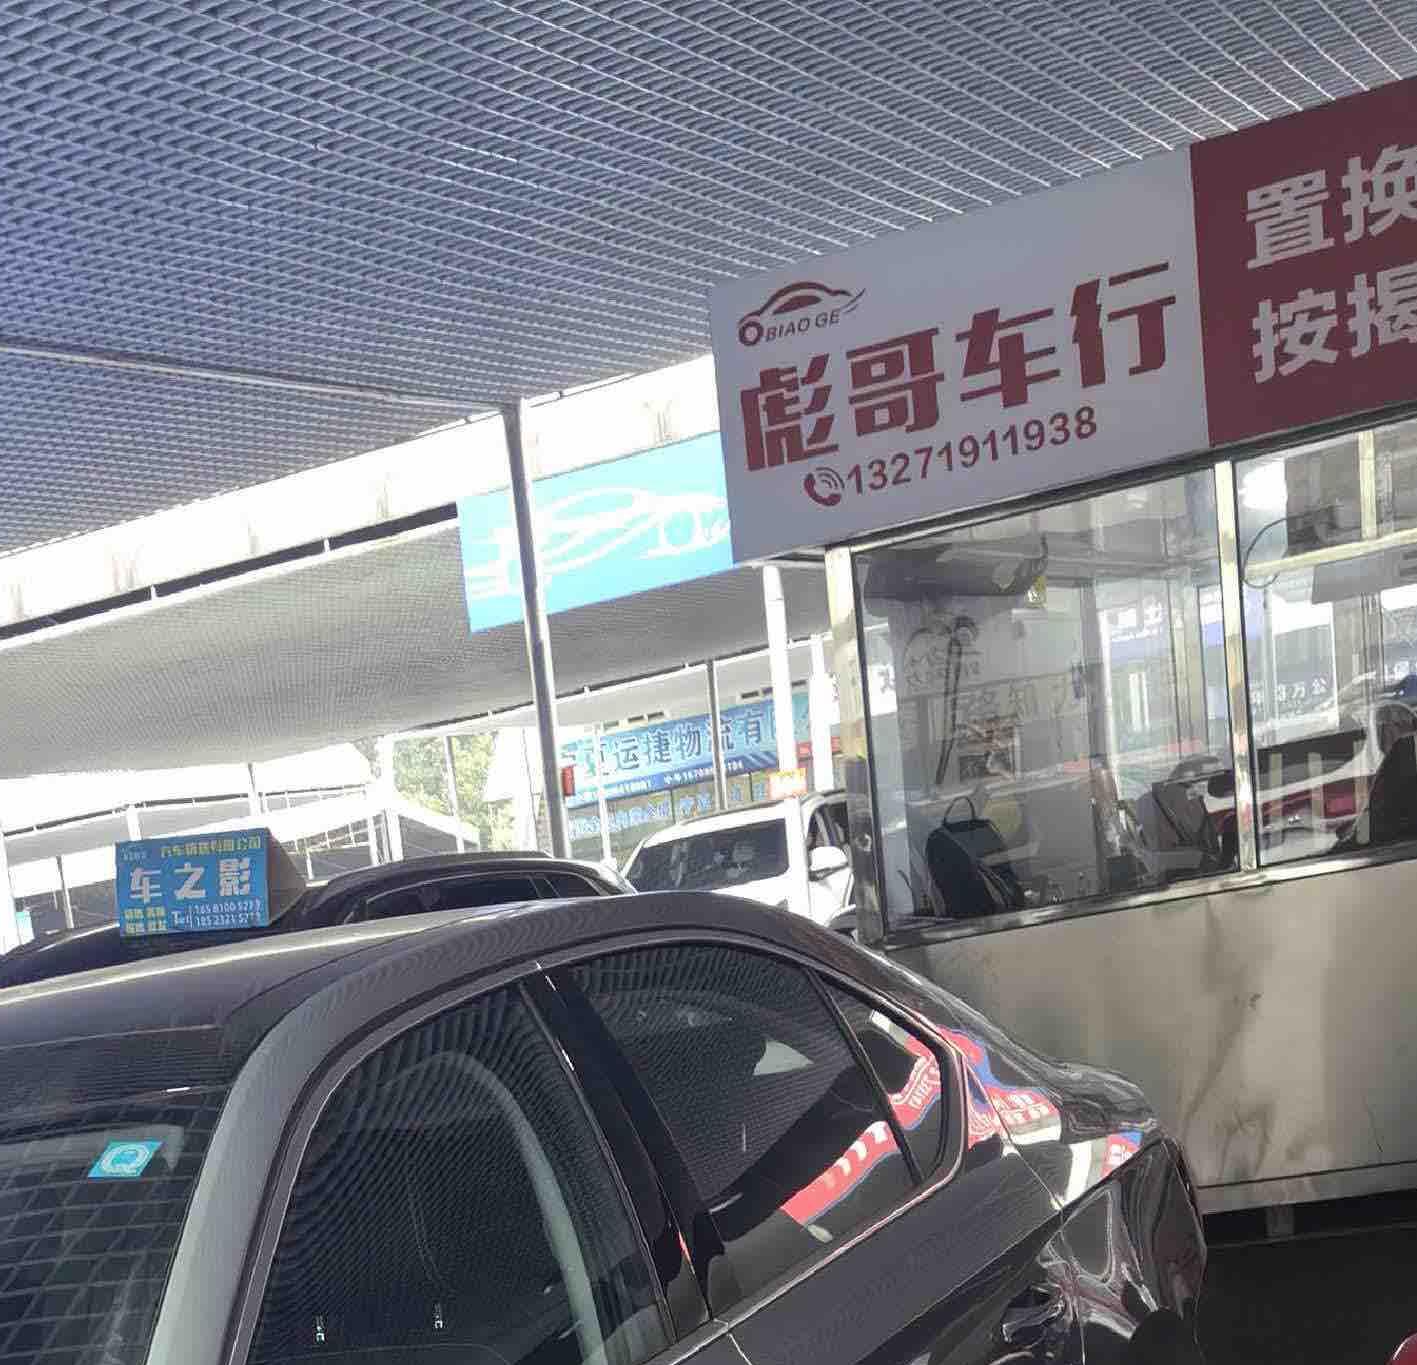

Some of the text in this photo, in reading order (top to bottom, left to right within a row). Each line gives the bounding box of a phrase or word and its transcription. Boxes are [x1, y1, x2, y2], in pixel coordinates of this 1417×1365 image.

[1245, 143, 1417, 269] 置换
[740, 261, 1178, 472] 彪哥车行
[765, 309, 841, 343] BIAO GE
[1252, 262, 1417, 384] 按揭
[846, 406, 1099, 496] 13271911938
[130, 857, 251, 904] 车之影
